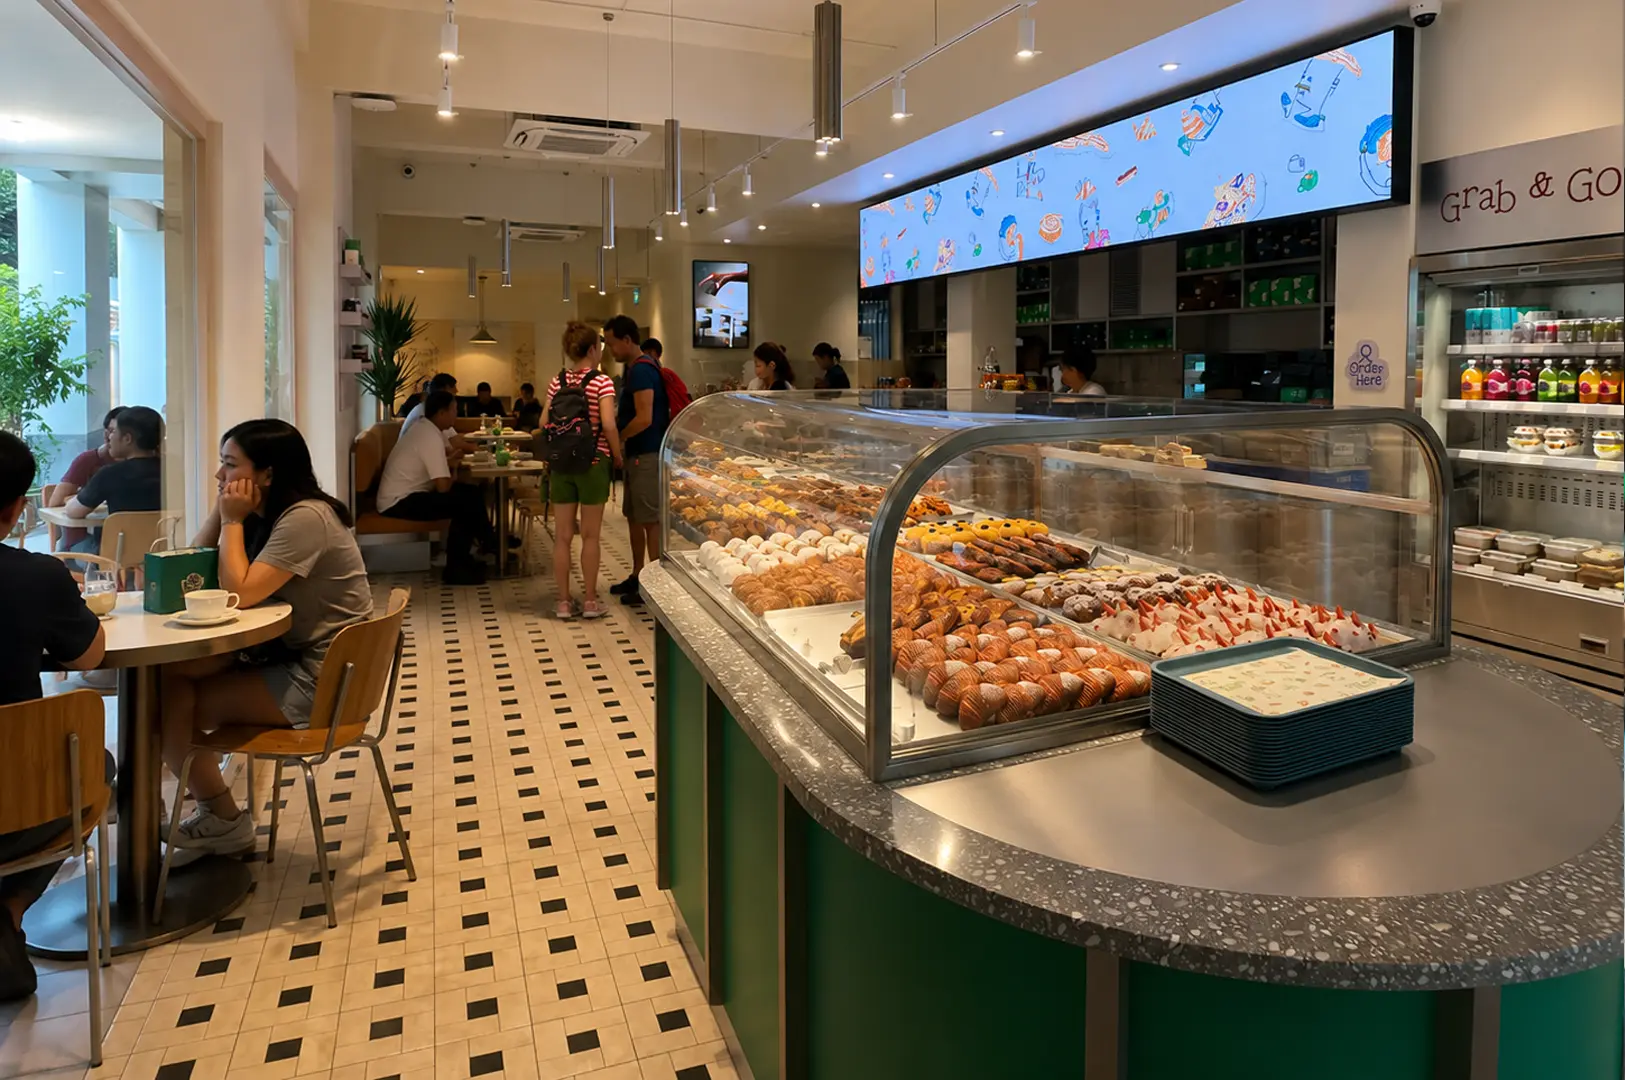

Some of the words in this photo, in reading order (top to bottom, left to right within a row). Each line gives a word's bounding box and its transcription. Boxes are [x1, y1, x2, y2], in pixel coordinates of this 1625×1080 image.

[1440, 178, 1517, 223] Grab
[1529, 171, 1555, 199] &
[1350, 361, 1384, 375] Order
[1356, 374, 1382, 386] Here
